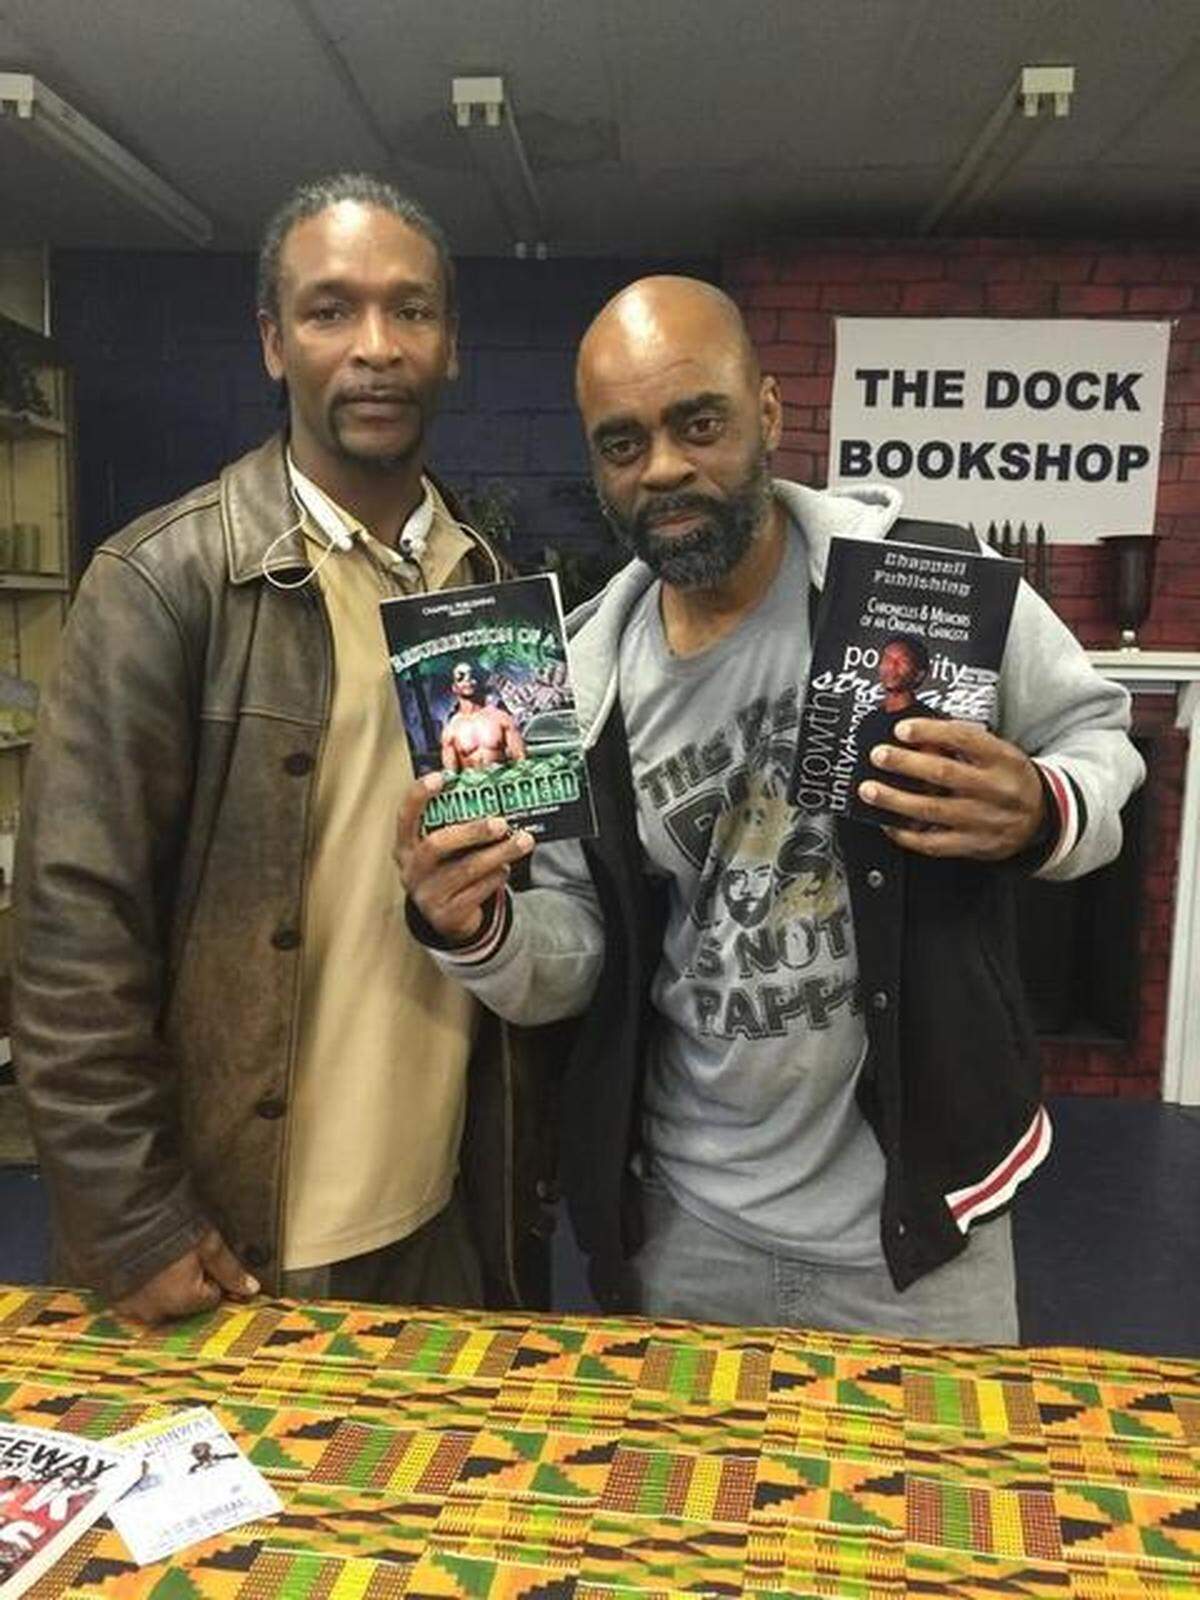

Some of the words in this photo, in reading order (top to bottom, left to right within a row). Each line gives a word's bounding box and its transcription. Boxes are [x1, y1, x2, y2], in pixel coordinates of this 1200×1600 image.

[855, 368, 965, 408] THE
[985, 370, 1143, 412] DOCK
[839, 439, 1150, 483] BOOKSHOP
[797, 689, 842, 809] growth
[501, 769, 581, 813] BREED
[734, 914, 849, 979] NOT
